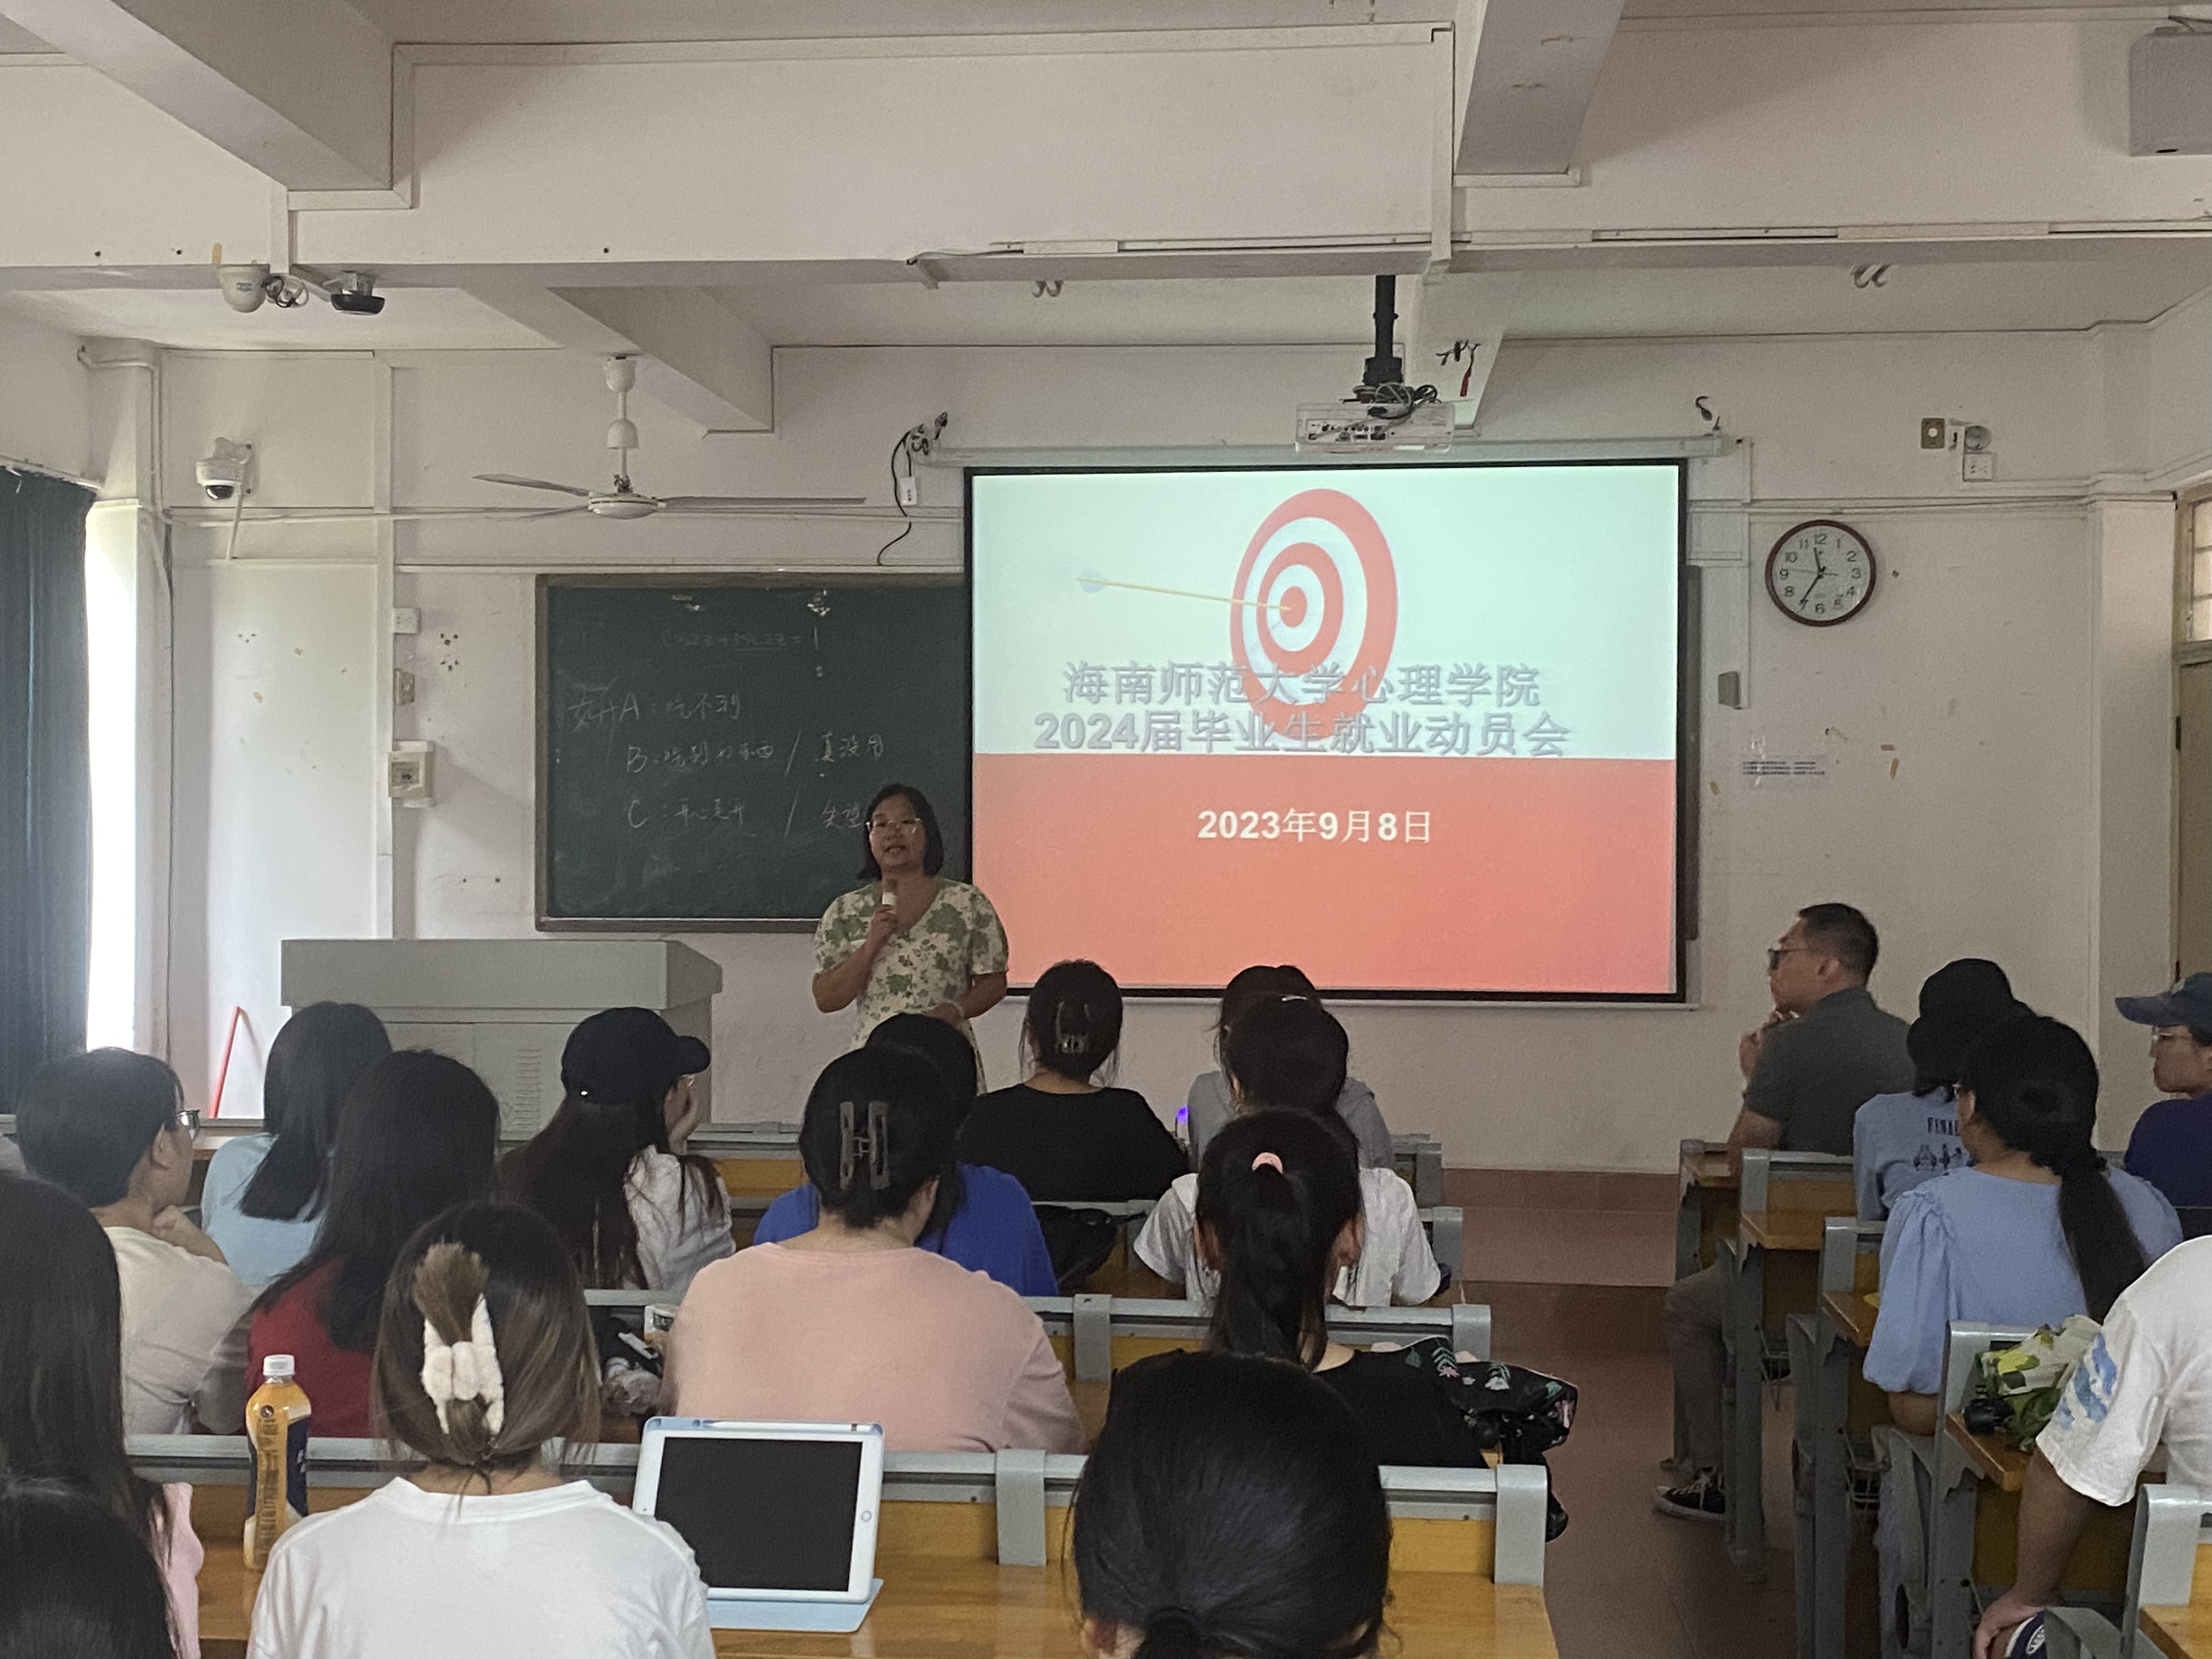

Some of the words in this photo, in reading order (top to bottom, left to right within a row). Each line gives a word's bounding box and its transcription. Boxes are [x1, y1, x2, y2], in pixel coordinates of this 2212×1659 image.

[1799, 539, 1808, 549] 11
[1814, 533, 1827, 545] 12
[1836, 539, 1841, 548] 1
[1785, 551, 1797, 563] 10
[1847, 551, 1857, 562] 2
[1780, 568, 1789, 580] 9
[1852, 568, 1861, 579] 3
[1785, 586, 1795, 597] 8
[1847, 586, 1855, 596] 4
[1815, 603, 1825, 614] 6
[1063, 660, 1540, 707] 海南师范大学心理学院
[1034, 709, 1571, 756] 2024届毕业生就业动员会
[1197, 808, 1431, 843] 2023年9月8日
